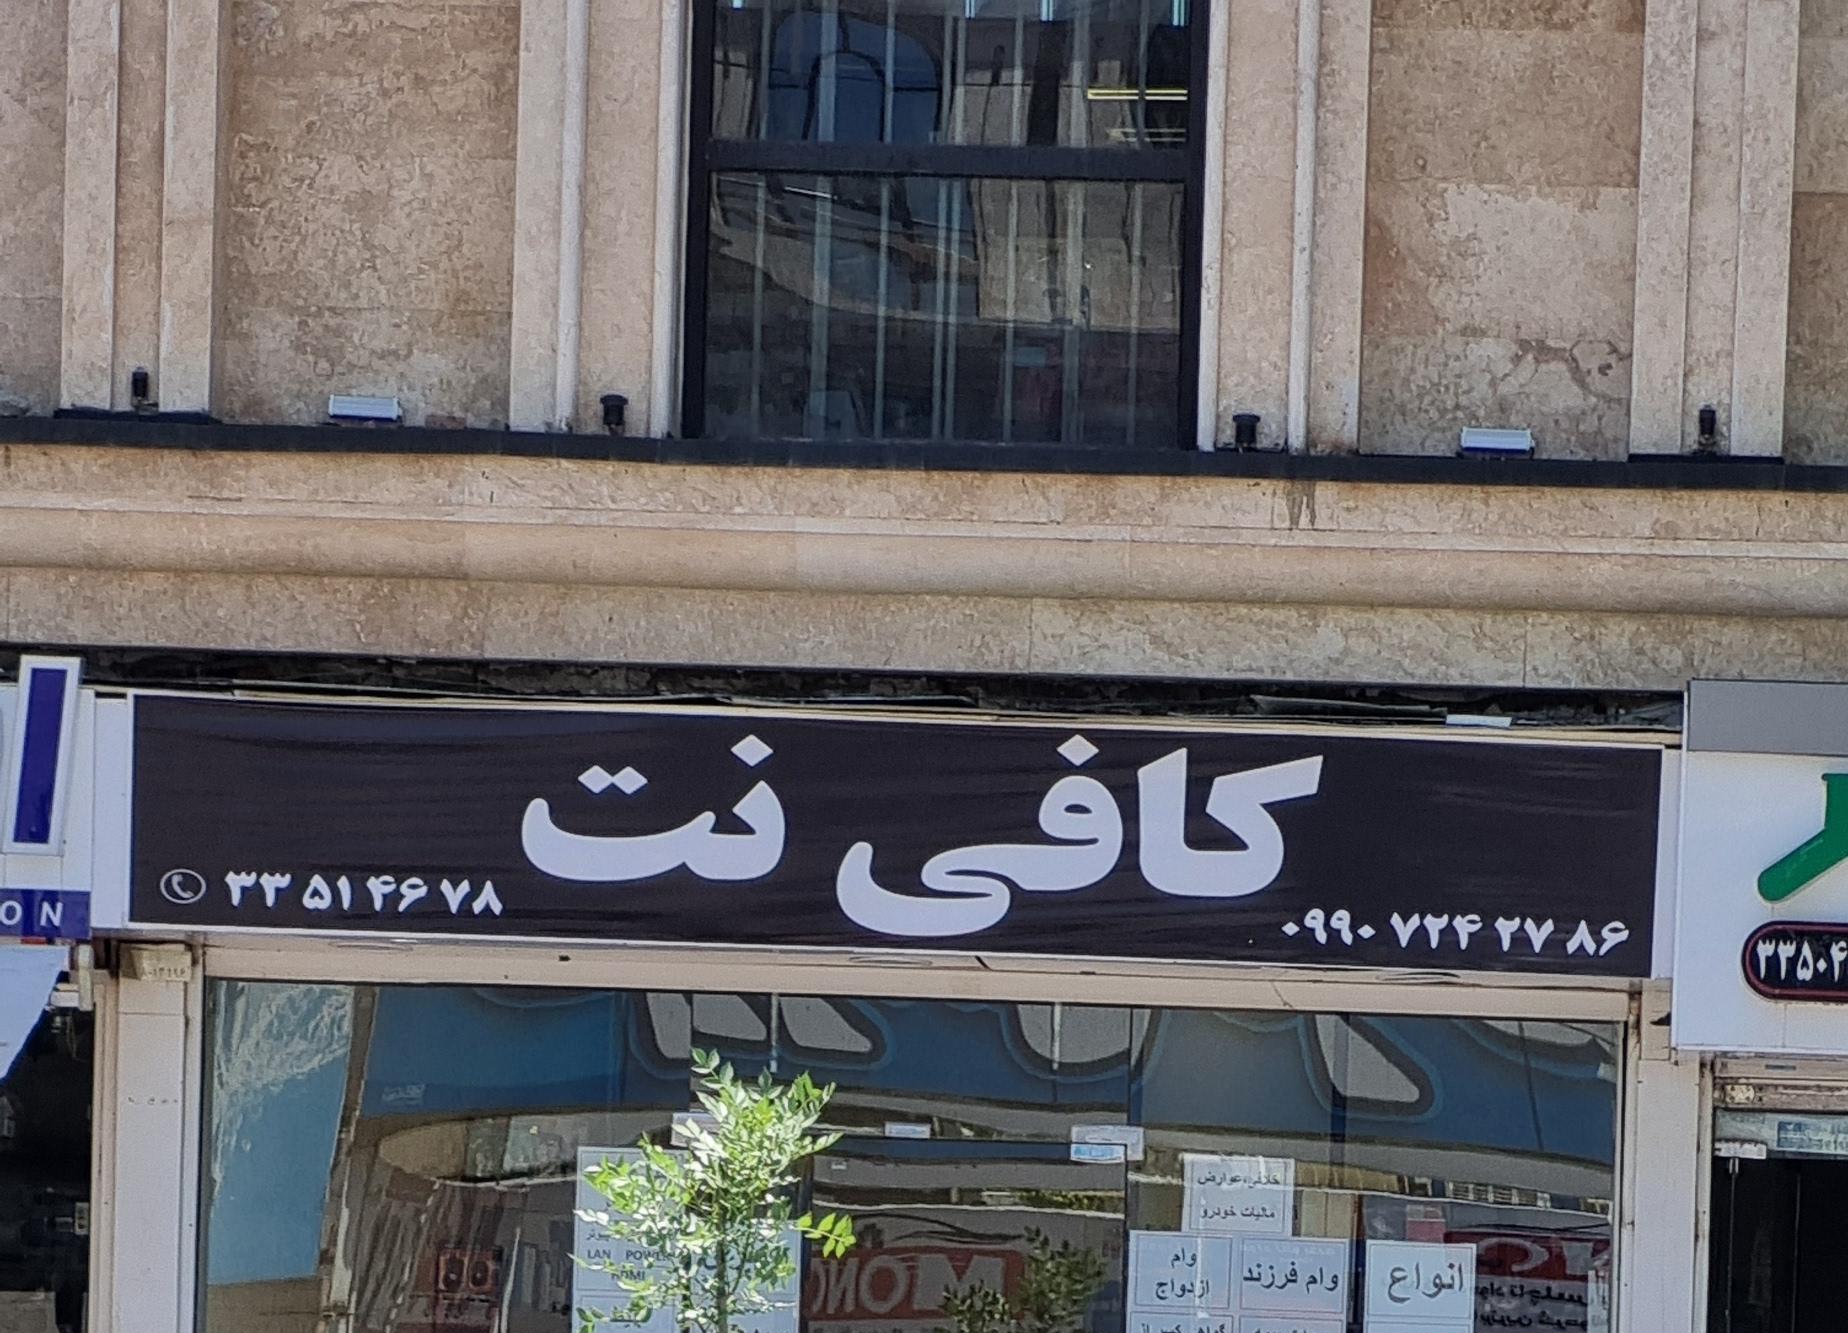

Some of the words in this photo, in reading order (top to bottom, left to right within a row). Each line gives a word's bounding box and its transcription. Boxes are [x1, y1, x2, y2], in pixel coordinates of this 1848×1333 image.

[521, 734, 786, 882] نت
[837, 734, 1323, 937] کافی
[225, 871, 291, 907] ۳۳
[302, 874, 350, 911] ۵۱
[366, 875, 428, 912] ۴۶
[440, 878, 503, 916] ۷۸
[1281, 908, 1376, 946] ۰۹۹۰
[1390, 912, 1483, 950] ۷۲۴
[1494, 916, 1555, 953] ۲۷
[1566, 920, 1630, 956] ۸۶
[1200, 1205, 1238, 1219] خودرو
[1241, 1206, 1276, 1220] مالیات
[587, 1249, 612, 1260] LAN
[1171, 1247, 1198, 1269] وام
[1155, 1279, 1210, 1300] ازدواج
[1243, 1261, 1299, 1290] فرزند
[1304, 1267, 1340, 1294] وام
[1388, 1262, 1463, 1304] انواع
